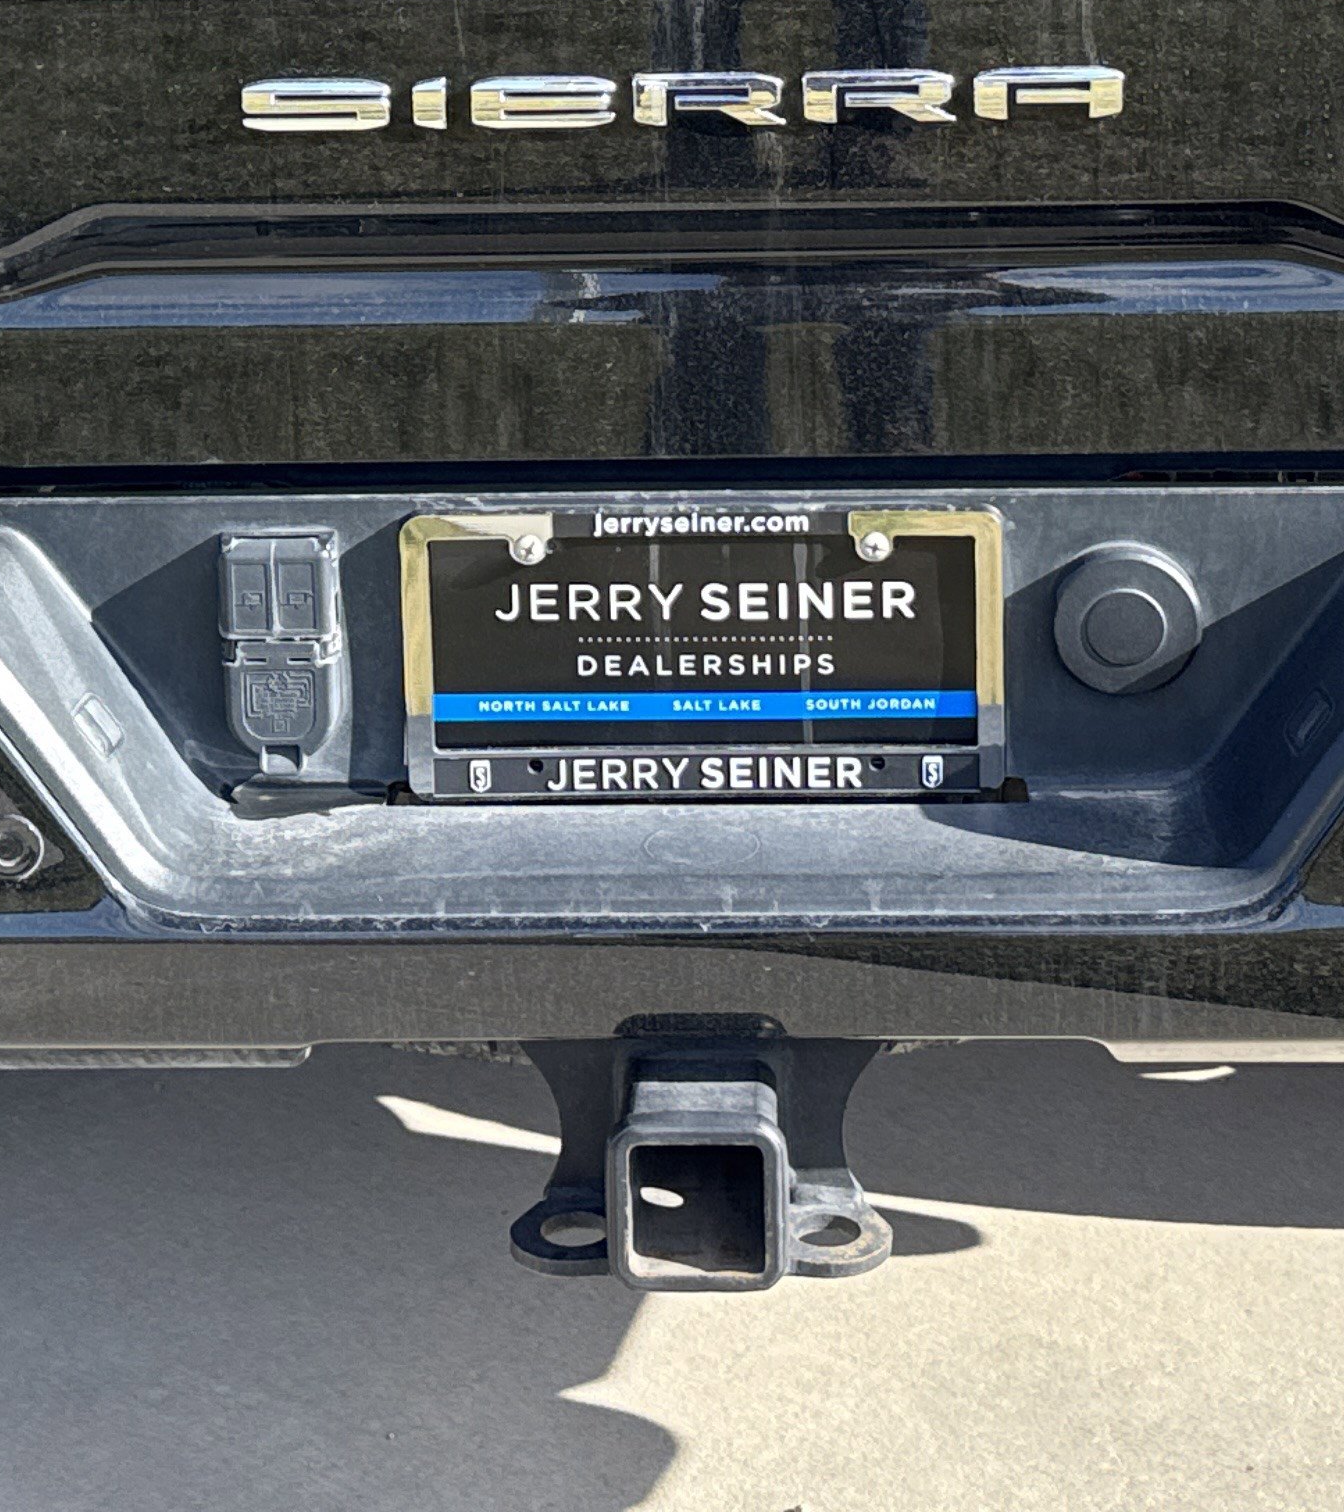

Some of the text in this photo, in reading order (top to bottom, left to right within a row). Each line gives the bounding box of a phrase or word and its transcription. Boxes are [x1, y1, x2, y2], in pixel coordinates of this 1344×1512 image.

[241, 65, 1126, 133] SIERRA
[593, 510, 810, 537] jerryseiner.com
[494, 580, 916, 622] JERRY SEINER
[576, 653, 836, 677] DEALERSHIPS
[478, 699, 631, 713] NORTH SALT LAKE
[672, 699, 762, 712] SALT LAKE
[806, 697, 936, 711] SOUTH JORDAN
[546, 755, 863, 791] JERRY SEINER
